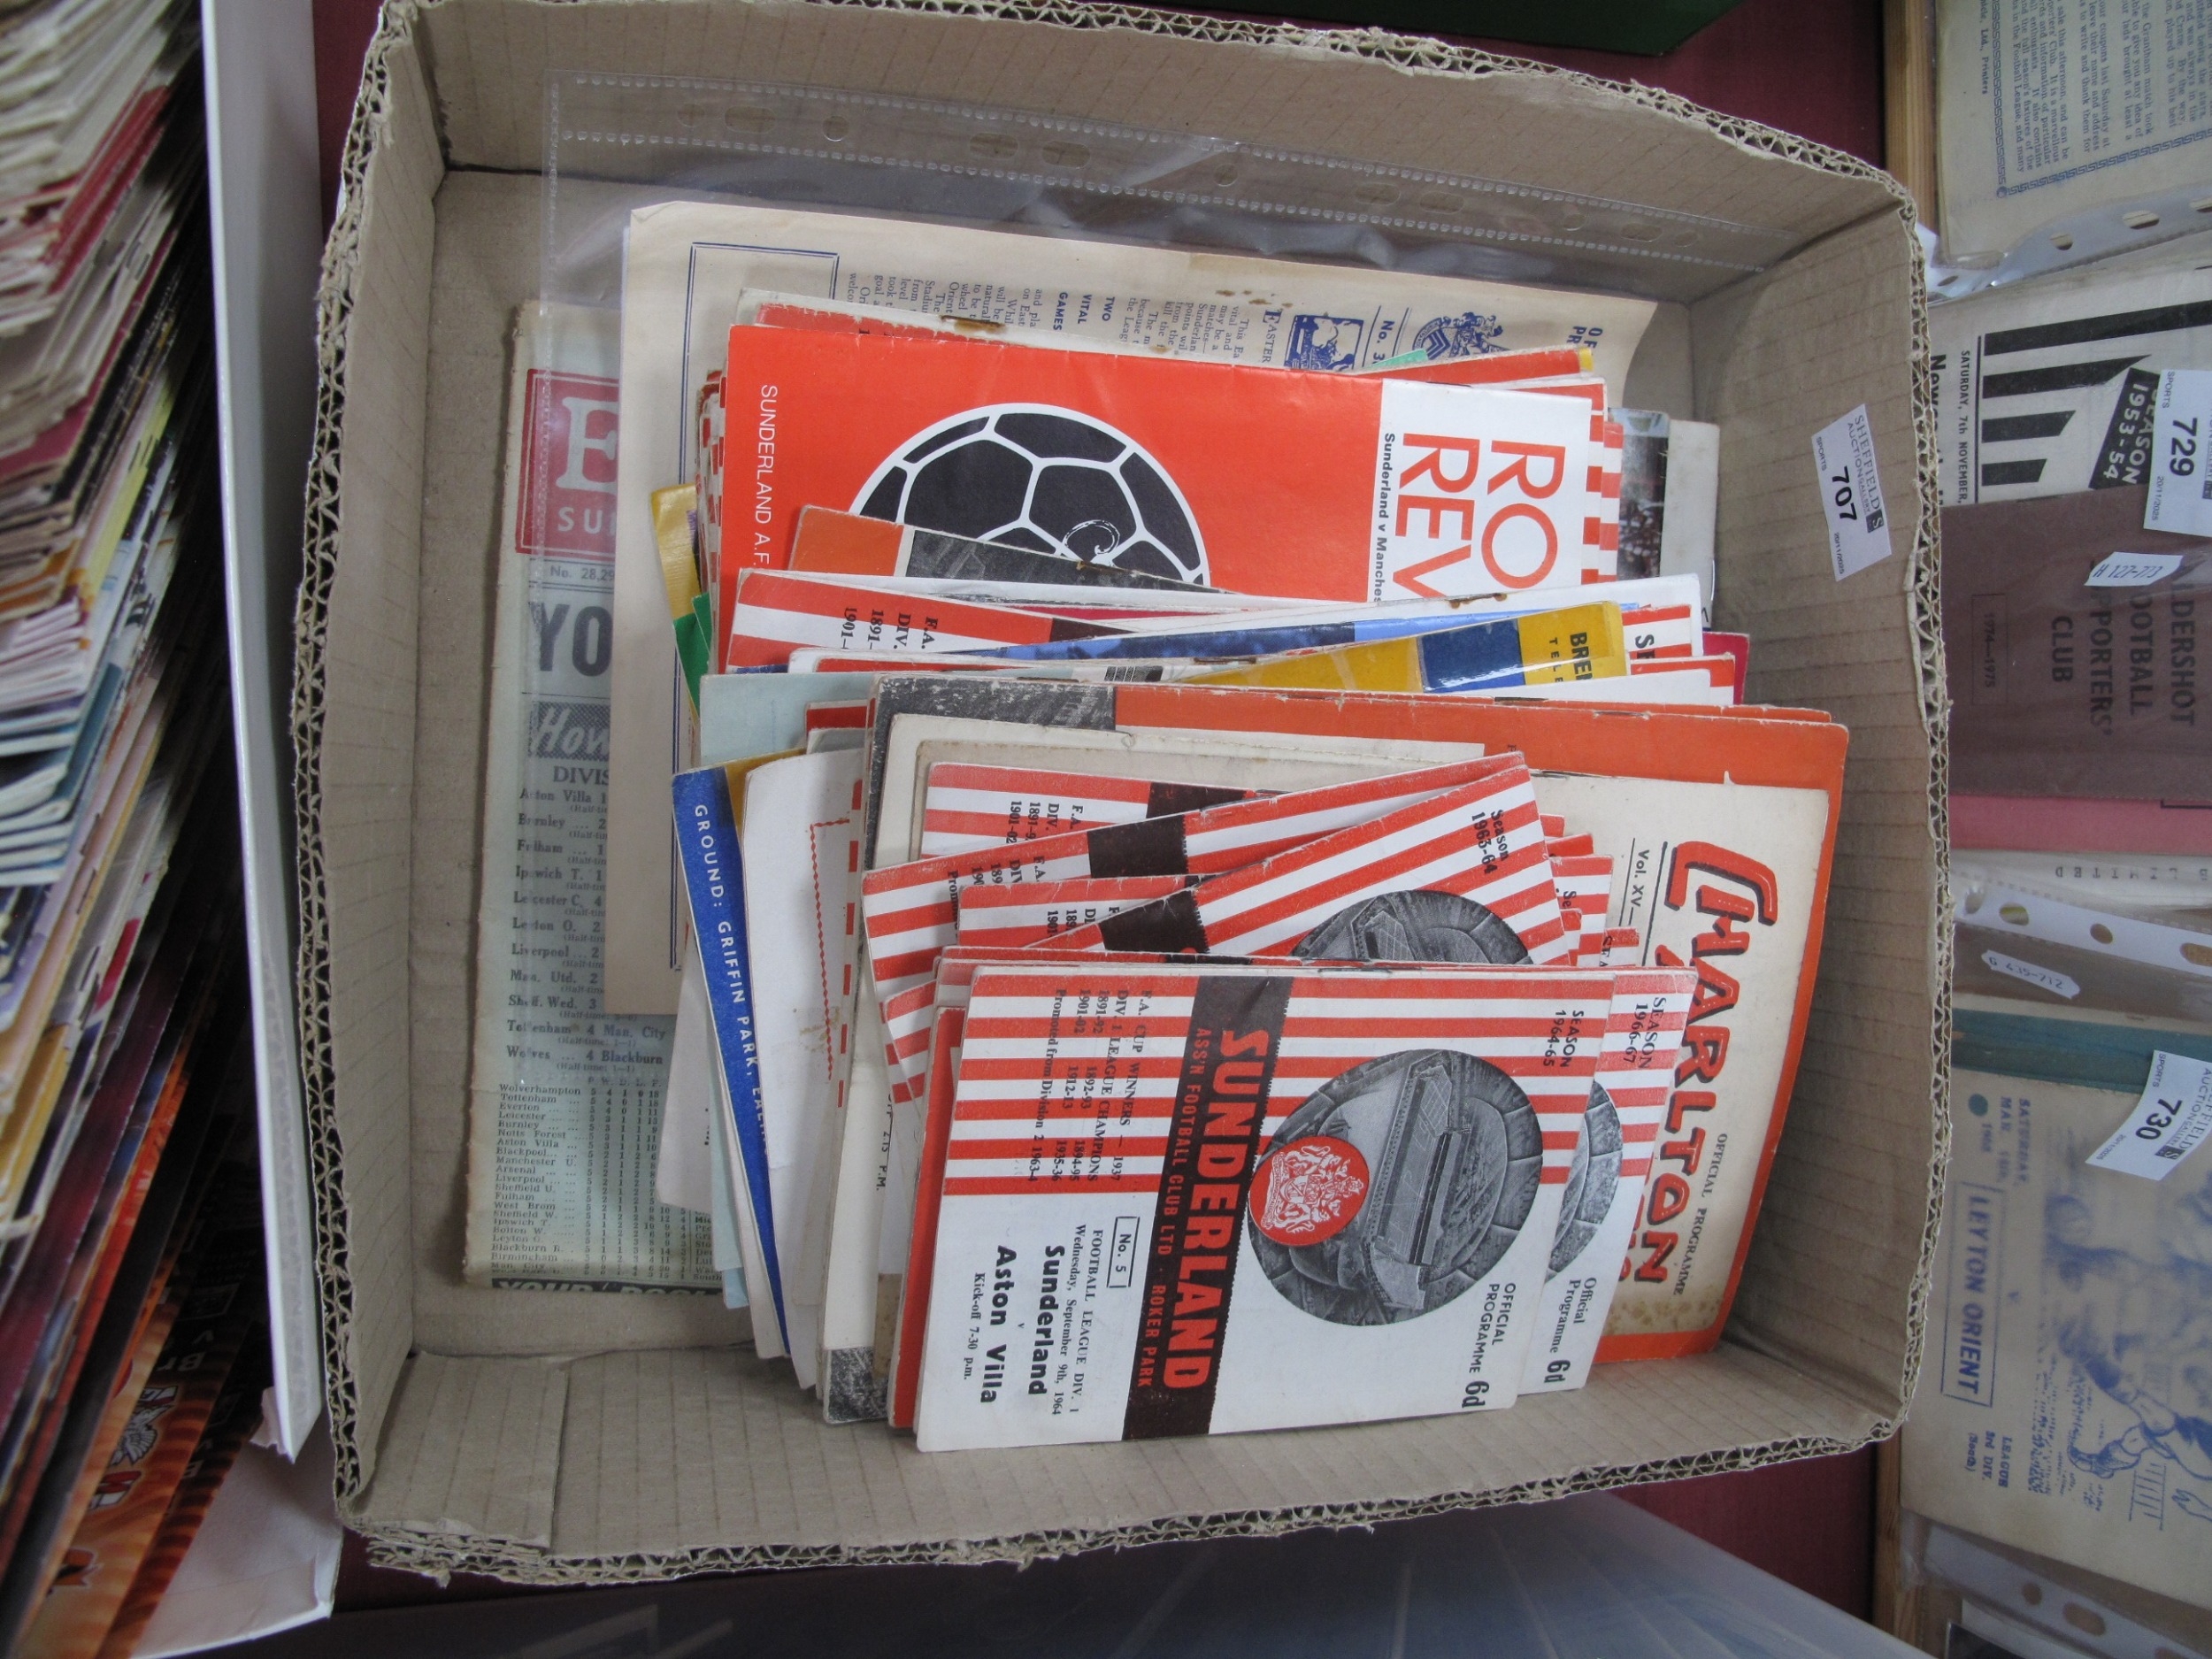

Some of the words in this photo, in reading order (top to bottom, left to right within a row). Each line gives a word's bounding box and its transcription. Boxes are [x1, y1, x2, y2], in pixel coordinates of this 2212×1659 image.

[2088, 2, 2098, 28] leave
[2013, 43, 2024, 84] Football
[2090, 31, 2100, 56] their
[2098, 23, 2108, 64] coupons
[2142, 22, 2152, 74] Grantham
[1981, 57, 1991, 96] Printers
[2039, 42, 2051, 101] information
[2081, 77, 2090, 106] thank
[2090, 59, 2099, 87] name
[2101, 66, 2110, 86] last
[2013, 84, 2024, 124] League,
[2100, 88, 2111, 134] Saturday
[2143, 79, 2153, 109] match
[2039, 116, 2052, 165] particular
[2050, 109, 2060, 164] marvellous
[2091, 113, 2101, 151] address
[2144, 112, 2154, 135] took
[2016, 146, 2025, 173] many
[2032, 127, 2043, 168] contains
[2082, 138, 2092, 153] for
[886, 276, 898, 298] took
[910, 279, 923, 303] from
[1053, 292, 1068, 331] GAMES
[1078, 294, 1092, 324] VITAL
[1102, 296, 1115, 321] TWO
[1134, 298, 1150, 334] because
[1182, 303, 1195, 331] points
[1228, 306, 1239, 326] vital
[1237, 319, 1249, 340] This
[1262, 310, 1282, 363] EASTER
[1376, 320, 1395, 343] No.
[1957, 349, 1970, 411] SATURDAY,
[2162, 371, 2176, 410] SPORTS
[1958, 415, 1968, 434] 7th
[754, 383, 779, 524] SUNDERLAND
[1815, 435, 1828, 472] SPORTS
[1854, 414, 1883, 511] SHEFFIELD
[2169, 417, 2199, 478] 729
[1378, 433, 1396, 519] Sunderland
[1831, 465, 1858, 521] 707
[1956, 442, 1968, 504] NOVEMBER,
[2151, 475, 2165, 522] 20/11/2025
[1377, 524, 1386, 533] v
[550, 565, 572, 579] No.
[894, 612, 911, 650] DIV.
[920, 617, 938, 650] F.A.
[2051, 615, 2074, 683] CLUB
[2129, 591, 2154, 716] OOTBALL
[1045, 803, 1060, 832] DIV.
[1070, 804, 1084, 830] F.A.
[1489, 810, 1510, 862] Season
[1471, 811, 1498, 875] 1963-64
[1632, 849, 1650, 879] Vol.
[693, 803, 724, 909] GROUND:
[716, 920, 747, 1005] GRIFFIN
[735, 1015, 760, 1079] PARK,
[1043, 988, 1066, 1044] Promoted
[1072, 988, 1091, 1034] 1901-02
[1091, 988, 1110, 1034] 1891-92
[1110, 989, 1128, 1019] DIV.
[1135, 989, 1154, 1017] F.A.
[603, 1024, 634, 1038] Man.
[641, 1026, 666, 1041] City
[1129, 1024, 1147, 1053] CUP
[1189, 1027, 1212, 1075] ASS'N
[1541, 1009, 1567, 1068] 1964-65
[1559, 1009, 1585, 1069] SEASON
[1622, 1001, 1648, 1064] 1966-67
[1637, 996, 1667, 1070] SEASON
[601, 1050, 664, 1065] Blackburn
[1041, 1046, 1060, 1077] from
[1099, 1036, 1121, 1095] LEAGUE
[1632, 840, 1779, 1285] CHARLTON
[2152, 1053, 2167, 1088] SPORTS
[499, 1084, 581, 1095] Wolverhampton
[500, 1093, 557, 1104] Tottenham
[1033, 1079, 1054, 1130] Division
[1061, 1064, 1079, 1110] 1912-13
[1079, 1064, 1098, 1110] 1892-93
[1118, 1061, 1143, 1127] WINNERS
[1086, 1099, 1113, 1182] CHAMPIONS
[1171, 1084, 1201, 1166] FOOTBALL
[2134, 1098, 2184, 1141] 730
[875, 1164, 888, 1192] P.M.
[1025, 1145, 1044, 1183] 1963-4
[1049, 1139, 1068, 1182] 1935-36
[1068, 1139, 1086, 1182] 1894-95
[1108, 1155, 1125, 1182] 1937
[1700, 1133, 1729, 1199] OFFICIAL
[1162, 1174, 1184, 1217] CLUB
[1162, 1028, 1271, 1389] SUNDERLAND
[1064, 1224, 1087, 1293] Wednesday,
[1117, 1233, 1133, 1260] No.
[1156, 1225, 1176, 1256] LTD
[1673, 1207, 1708, 1296] PROGRAMME
[1963, 1194, 1991, 1292] LEYTON
[987, 1244, 1018, 1326] Aston
[1082, 1228, 1104, 1302] FOOTBALL
[1114, 1265, 1129, 1274] 5
[969, 1271, 986, 1321] Kick-off
[1144, 1285, 1168, 1338] ROKER
[1491, 1282, 1517, 1346] OFFICIAL
[1547, 1279, 1580, 1355] Programme
[1572, 1277, 1597, 1325] Official
[966, 1325, 981, 1351] 7-30
[1027, 1244, 1066, 1396] Sunderland
[1056, 1298, 1079, 1356] September
[1074, 1310, 1096, 1365] LEAGUE
[1468, 1282, 1499, 1374] PROGRAMME
[962, 1356, 976, 1381] p.m.
[1136, 1346, 1157, 1388] PARK
[1956, 1302, 1985, 1394] ORIENT
[979, 1343, 1009, 1404] Villa
[1053, 1363, 1070, 1386] 9th,
[1071, 1372, 1086, 1402] DIV.
[1542, 1359, 1572, 1385] 6d
[1051, 1390, 1066, 1416] 1964
[1461, 1380, 1491, 1409] 6d
[1981, 1456, 1994, 1481] DIV.
[1997, 1435, 2013, 1489] LEAGUE
